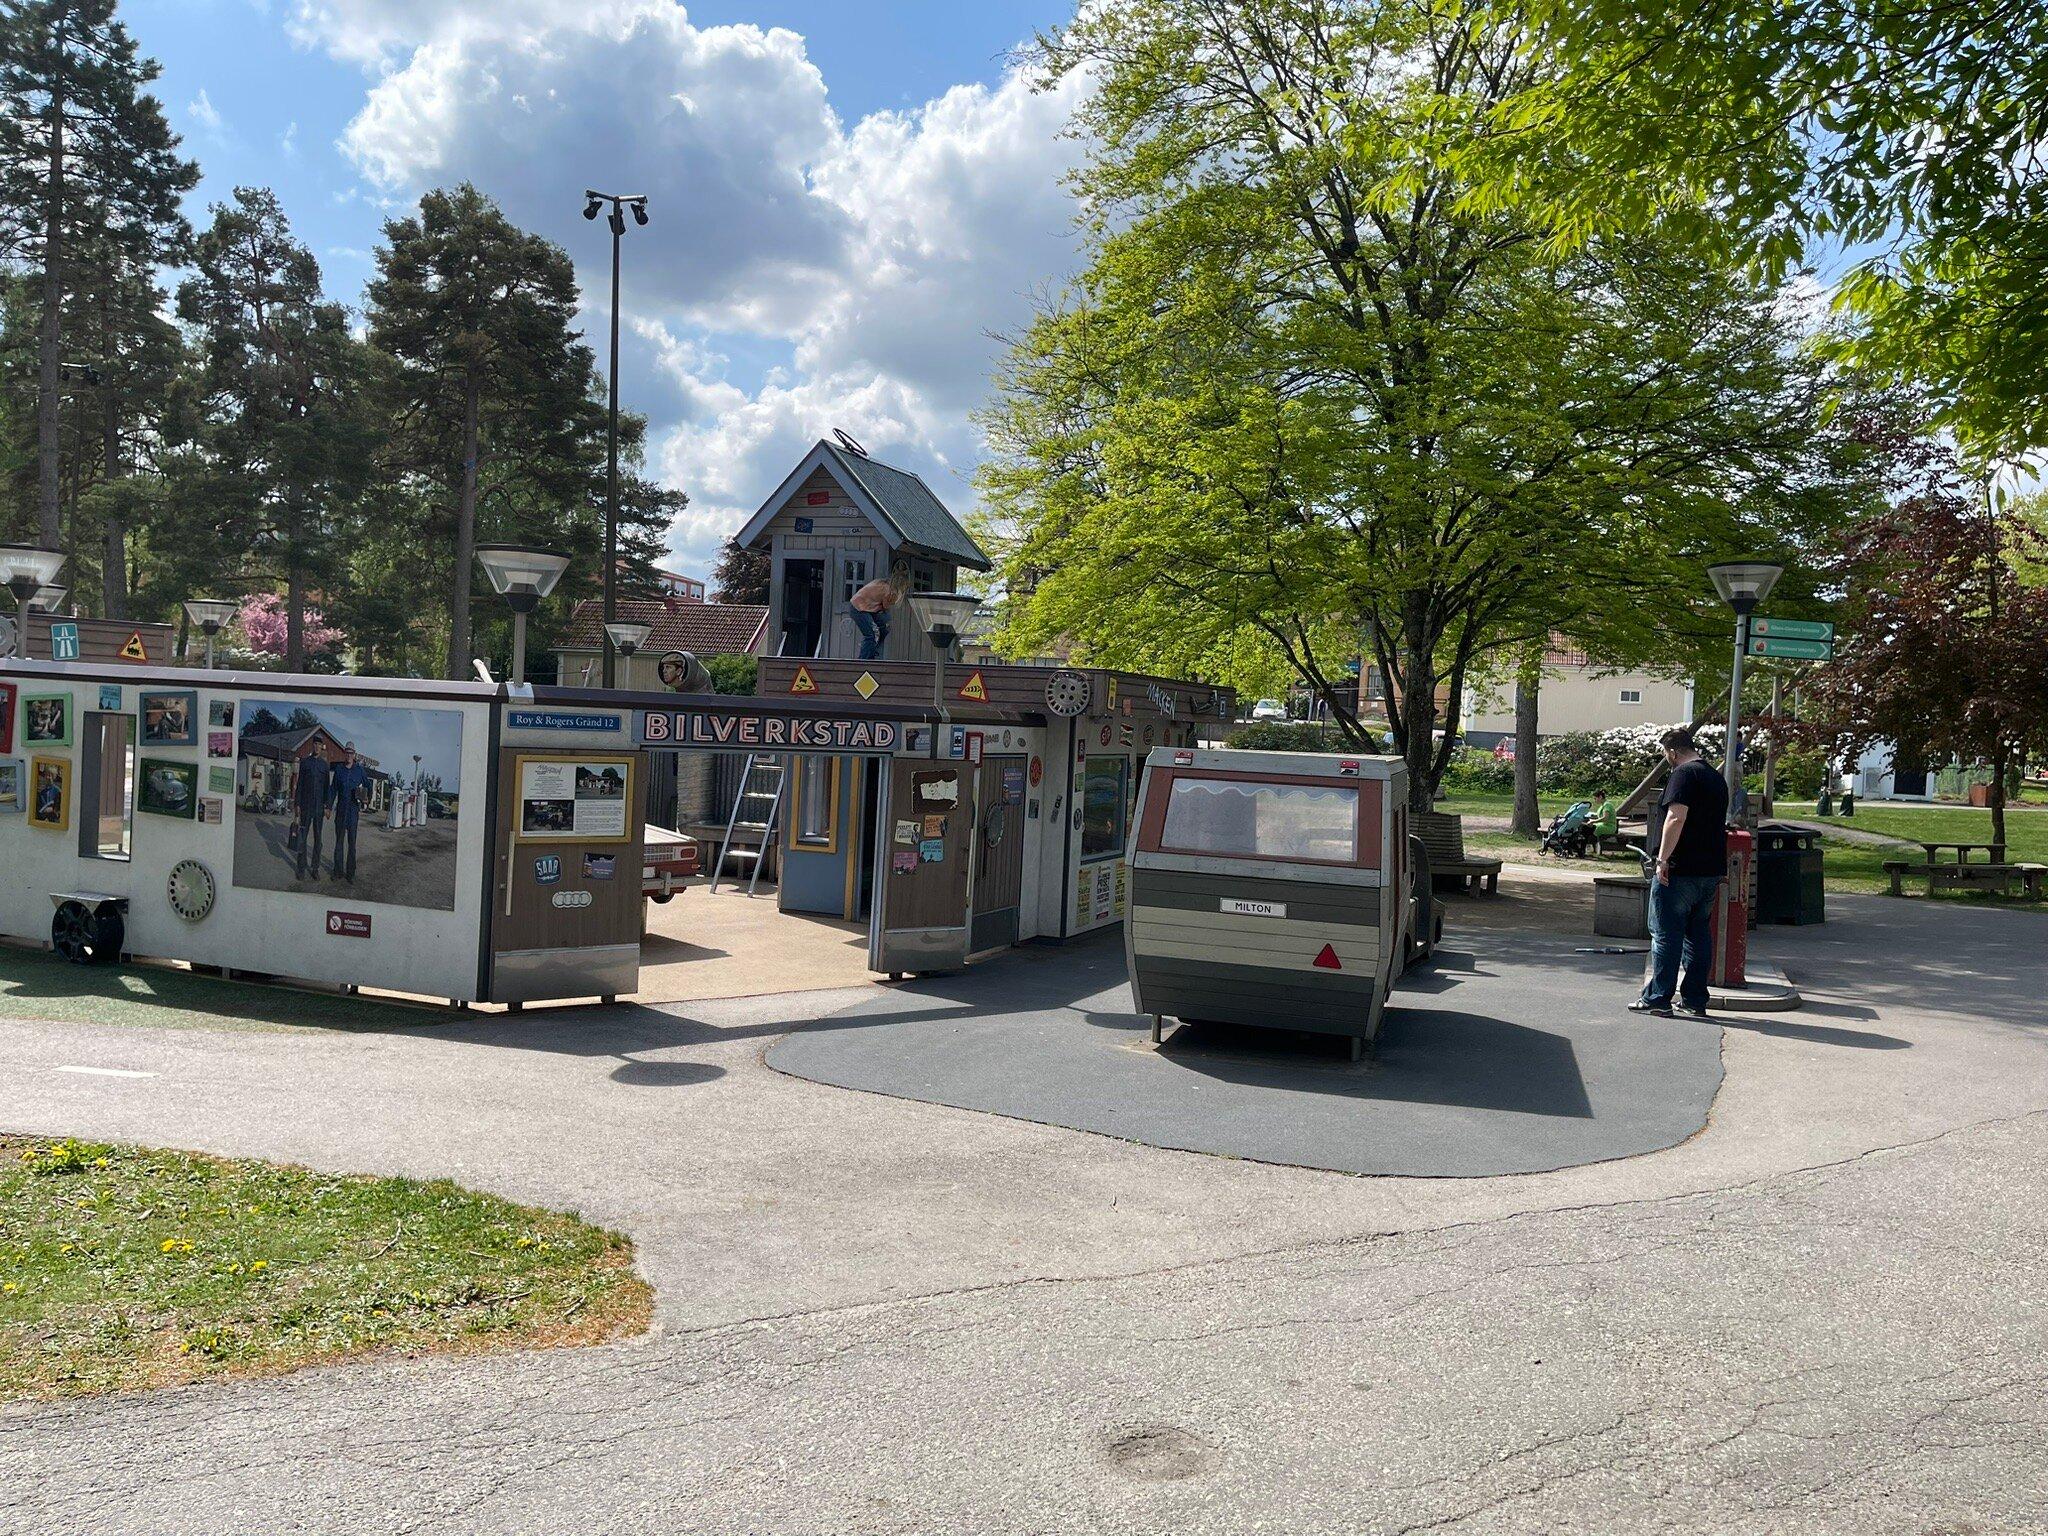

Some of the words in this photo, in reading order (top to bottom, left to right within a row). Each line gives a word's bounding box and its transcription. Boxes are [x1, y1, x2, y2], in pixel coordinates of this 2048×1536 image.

[516, 715, 532, 725] Roy
[535, 715, 543, 724] &
[545, 715, 574, 728] Rogers
[604, 718, 614, 727] 12
[645, 712, 895, 747] BILVERKSTAD
[535, 859, 559, 876] SAAB
[1235, 902, 1271, 913] MILTON
